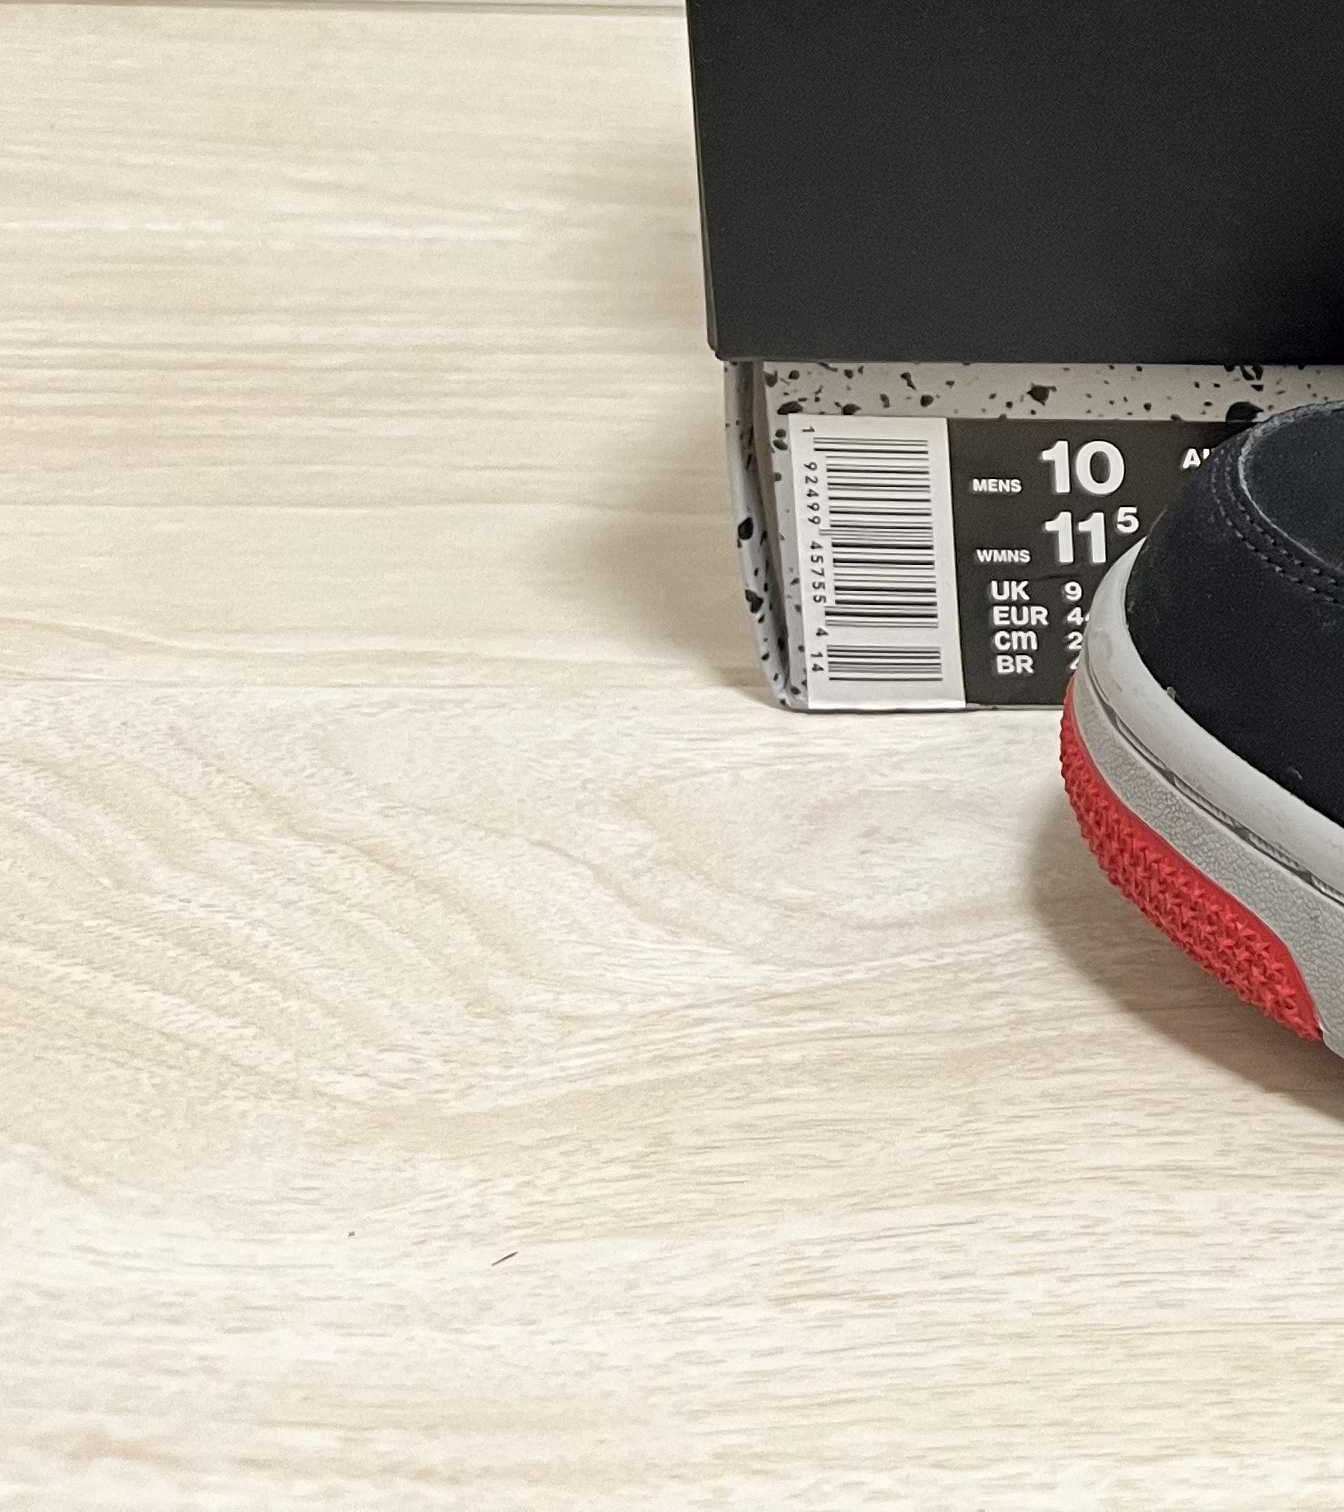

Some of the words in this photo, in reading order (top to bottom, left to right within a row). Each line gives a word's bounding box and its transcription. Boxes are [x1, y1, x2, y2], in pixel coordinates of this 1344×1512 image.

[971, 477, 1023, 493] MENS
[1039, 439, 1125, 495] 10
[803, 461, 821, 525] 92499
[975, 548, 1032, 563] WMNS
[810, 540, 827, 604] 45755
[990, 579, 1031, 601] UK
[1063, 580, 1083, 601] 9
[992, 605, 1050, 626] EUR
[815, 627, 829, 637] 4
[810, 651, 825, 672] 14
[996, 654, 1035, 675] BR
